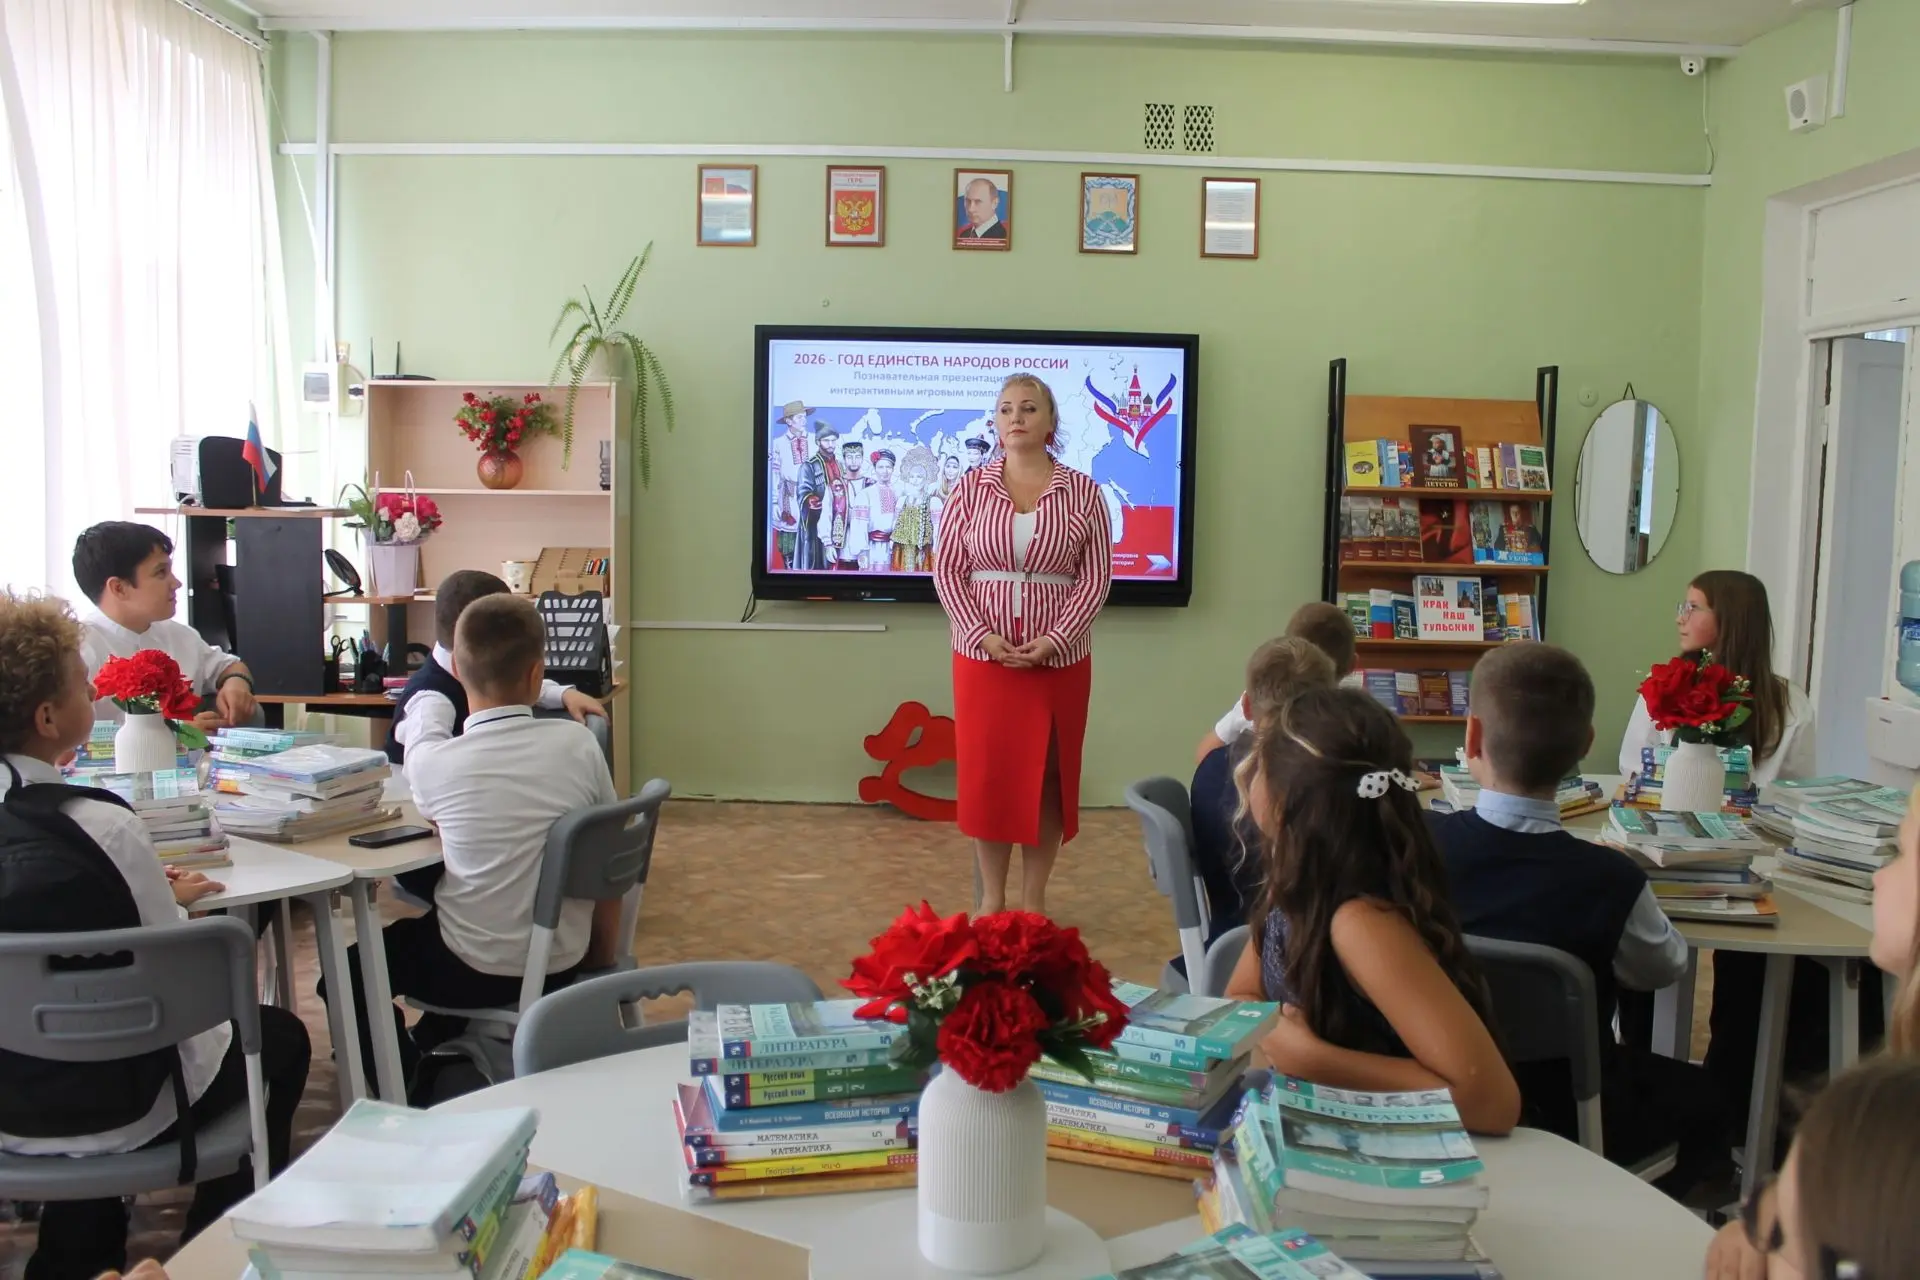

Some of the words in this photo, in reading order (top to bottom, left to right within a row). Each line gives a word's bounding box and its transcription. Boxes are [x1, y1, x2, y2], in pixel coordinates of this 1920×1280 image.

[794, 353, 826, 365] 2026
[838, 354, 865, 368] ГОД
[868, 354, 939, 368] ЕДИНСТВА
[943, 356, 1010, 370] НАРОДОВ
[1014, 357, 1069, 370] РОССИИ
[853, 371, 940, 382] Познавательная
[830, 387, 915, 396] интерактивным
[917, 388, 964, 397] игровым
[966, 388, 1000, 398] компо
[1424, 481, 1459, 489] ДЕТСТВО
[1443, 611, 1465, 620] НАШ
[760, 1038, 848, 1054] ЛИТЕРАТУРА
[880, 1035, 892, 1044] 5
[1175, 1039, 1186, 1049] 5
[846, 1054, 857, 1063] 5
[1150, 1052, 1161, 1062] 5
[763, 1072, 788, 1084] Русский
[790, 1071, 805, 1079] язык
[764, 1089, 788, 1100] Русский
[790, 1088, 806, 1096] язык
[1089, 1096, 1122, 1111] ВСЕОБЩАЯ
[1123, 1104, 1150, 1116] ИСТОРИЯ
[824, 1109, 862, 1120] ВСЕОБЩАЯ
[863, 1107, 890, 1118] ИСТОРИЯ
[1052, 1118, 1108, 1132] МАТЕМАТИКА
[757, 1132, 819, 1142] МАТЕМАТИКА
[872, 1130, 882, 1138] 5
[771, 1144, 832, 1155] МАТЕМАТИКА
[1419, 1170, 1444, 1184] 5
